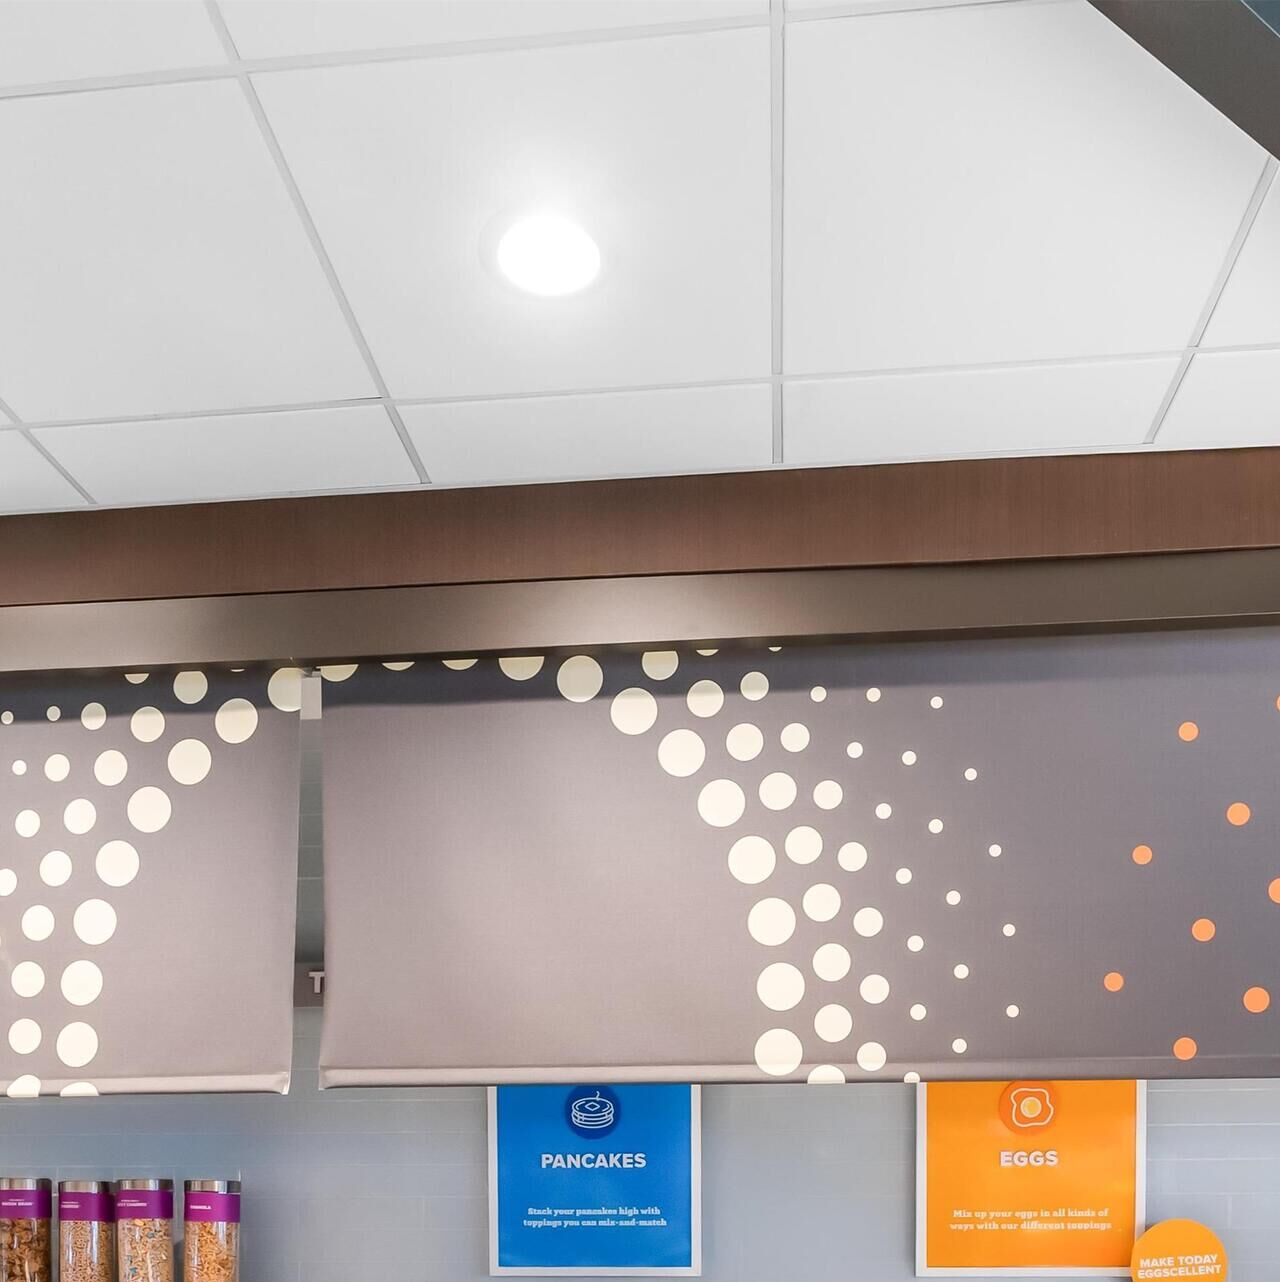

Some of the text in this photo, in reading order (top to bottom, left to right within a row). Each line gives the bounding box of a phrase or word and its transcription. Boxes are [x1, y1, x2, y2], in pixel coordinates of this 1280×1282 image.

[541, 1153, 647, 1168] PANCAKES
[1000, 1151, 1058, 1166] EGGS
[527, 1206, 661, 1217] Stack your pancakes high with
[953, 1207, 1109, 1220] Mix up your eggs in all kinds of
[523, 1218, 562, 1228] toppings
[563, 1220, 580, 1228] you
[598, 1218, 667, 1227] mix-and-match
[950, 1222, 974, 1231] ways
[976, 1221, 999, 1230] with
[1001, 1222, 1019, 1230] our
[1020, 1220, 1065, 1230] different
[1140, 1254, 1218, 1268] MAKE TODAY
[1137, 1264, 1222, 1279] EGGSCELLENT
